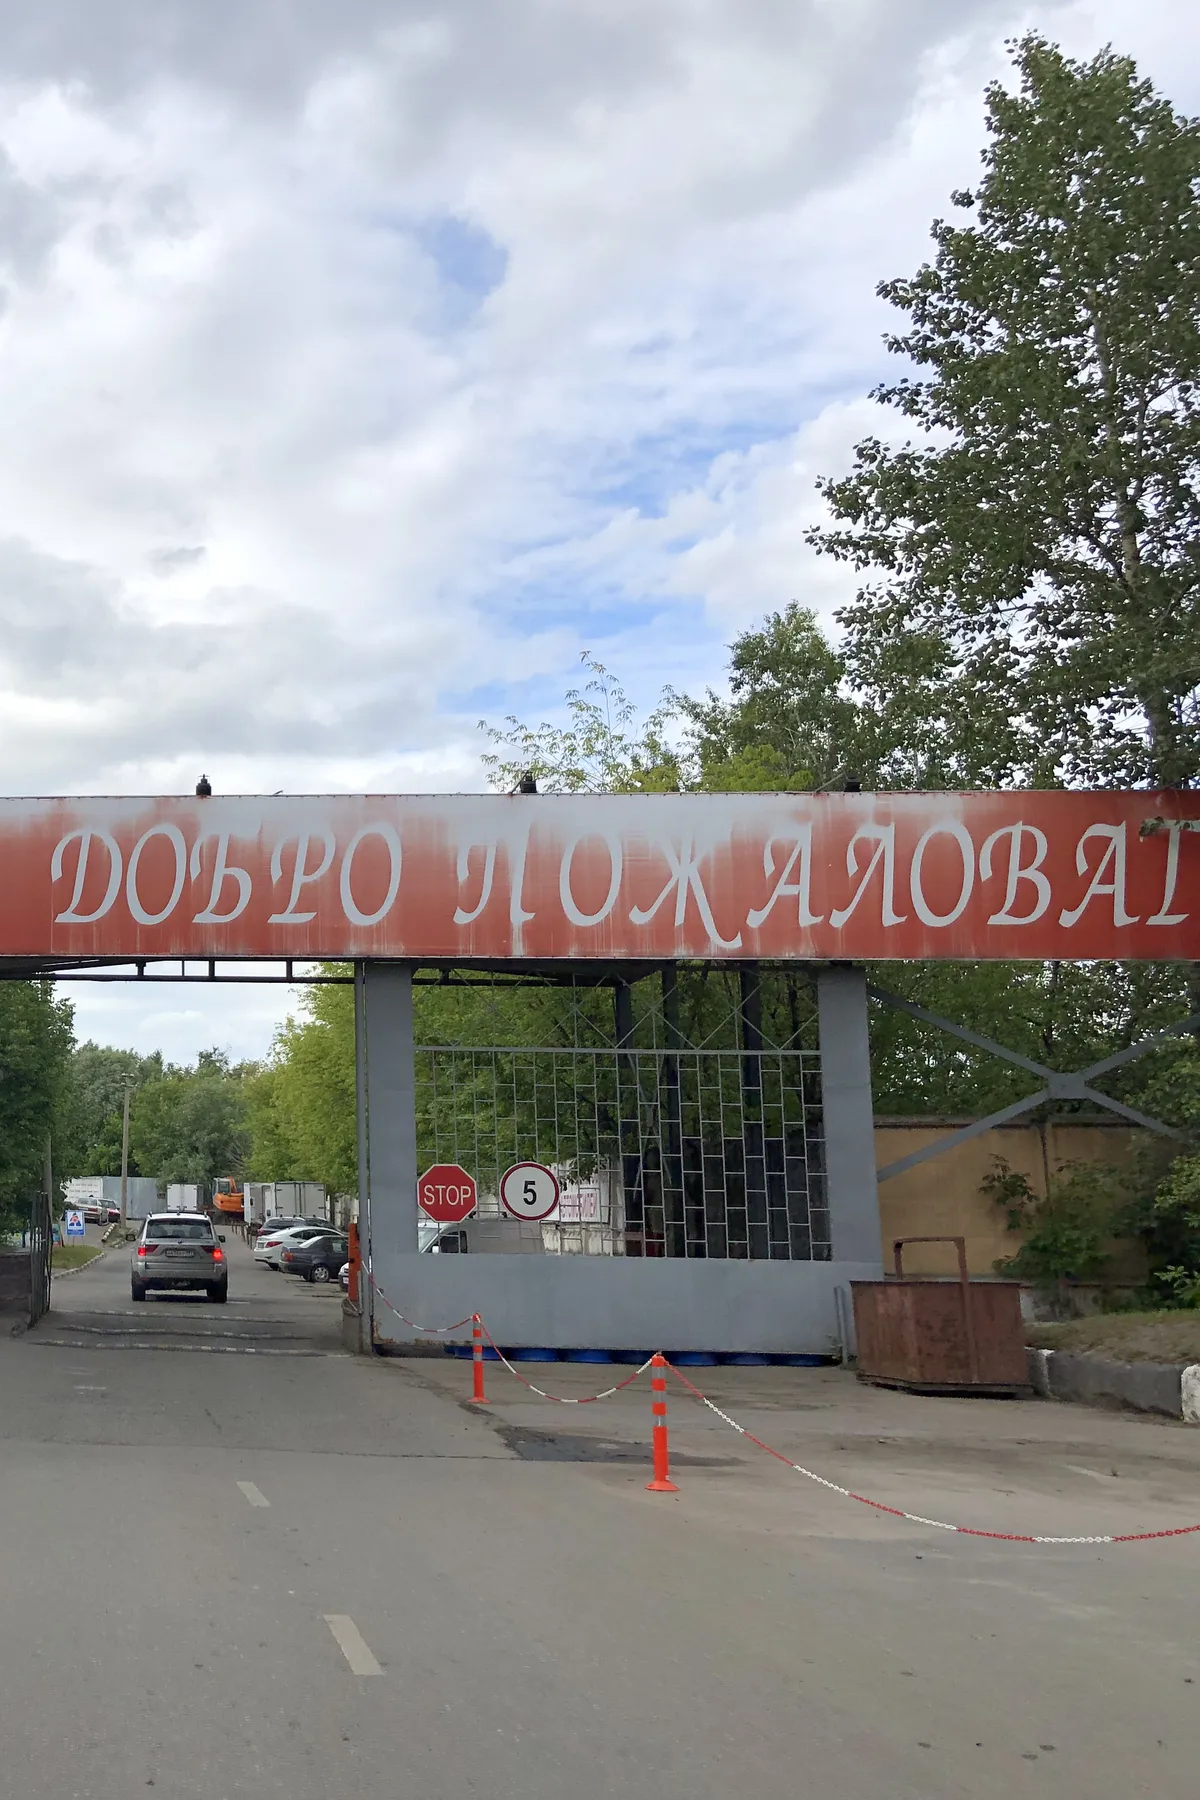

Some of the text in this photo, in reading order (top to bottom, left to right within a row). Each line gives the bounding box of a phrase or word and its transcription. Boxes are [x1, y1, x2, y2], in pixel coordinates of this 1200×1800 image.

[49, 821, 403, 926] ДОБРО
[423, 1184, 472, 1206] STOP
[523, 1180, 537, 1206] 5
